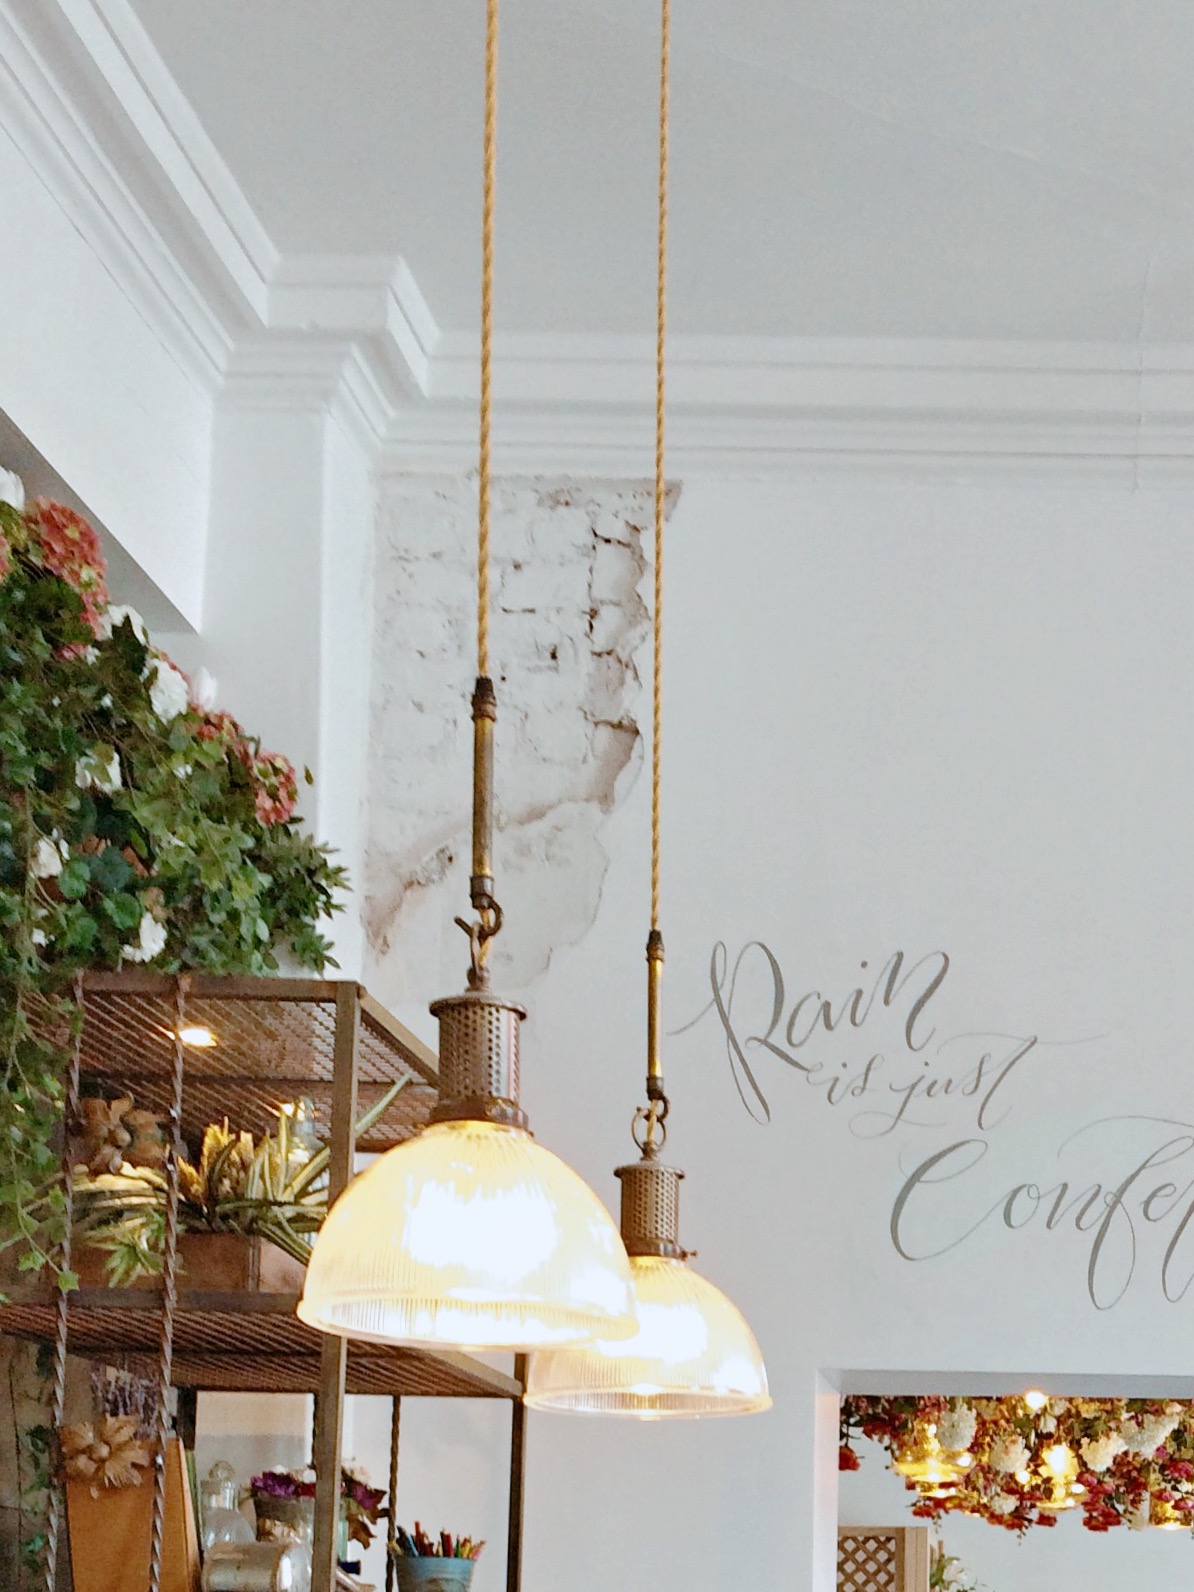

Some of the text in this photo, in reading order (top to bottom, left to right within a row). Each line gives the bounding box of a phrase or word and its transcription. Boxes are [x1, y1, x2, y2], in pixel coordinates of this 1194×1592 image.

[667, 941, 949, 1126] Rain
[806, 1032, 1104, 1138] is just
